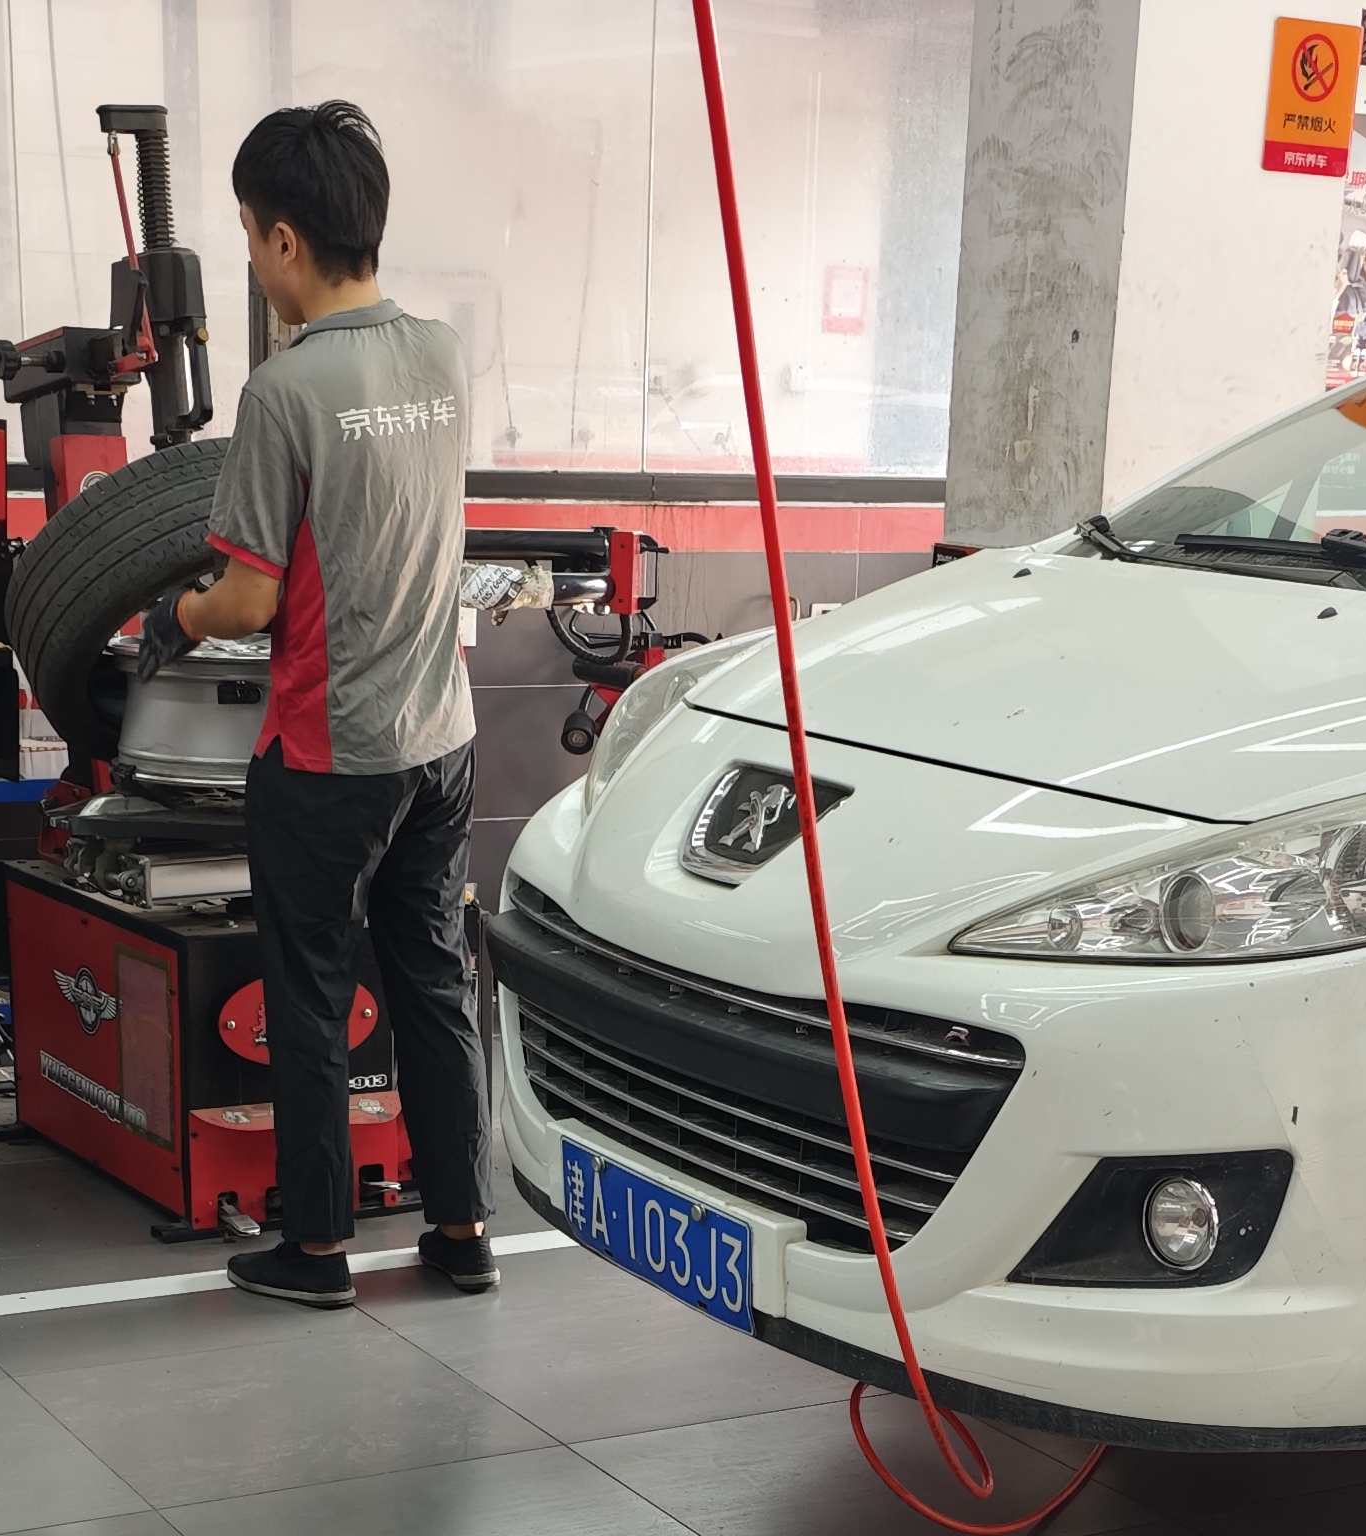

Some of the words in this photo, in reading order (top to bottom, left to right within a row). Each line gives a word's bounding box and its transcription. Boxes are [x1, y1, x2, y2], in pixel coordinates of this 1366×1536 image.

[1283, 113, 1337, 134] 严禁烟火
[1284, 151, 1328, 169] 京东养车
[335, 395, 457, 442] 京东养车
